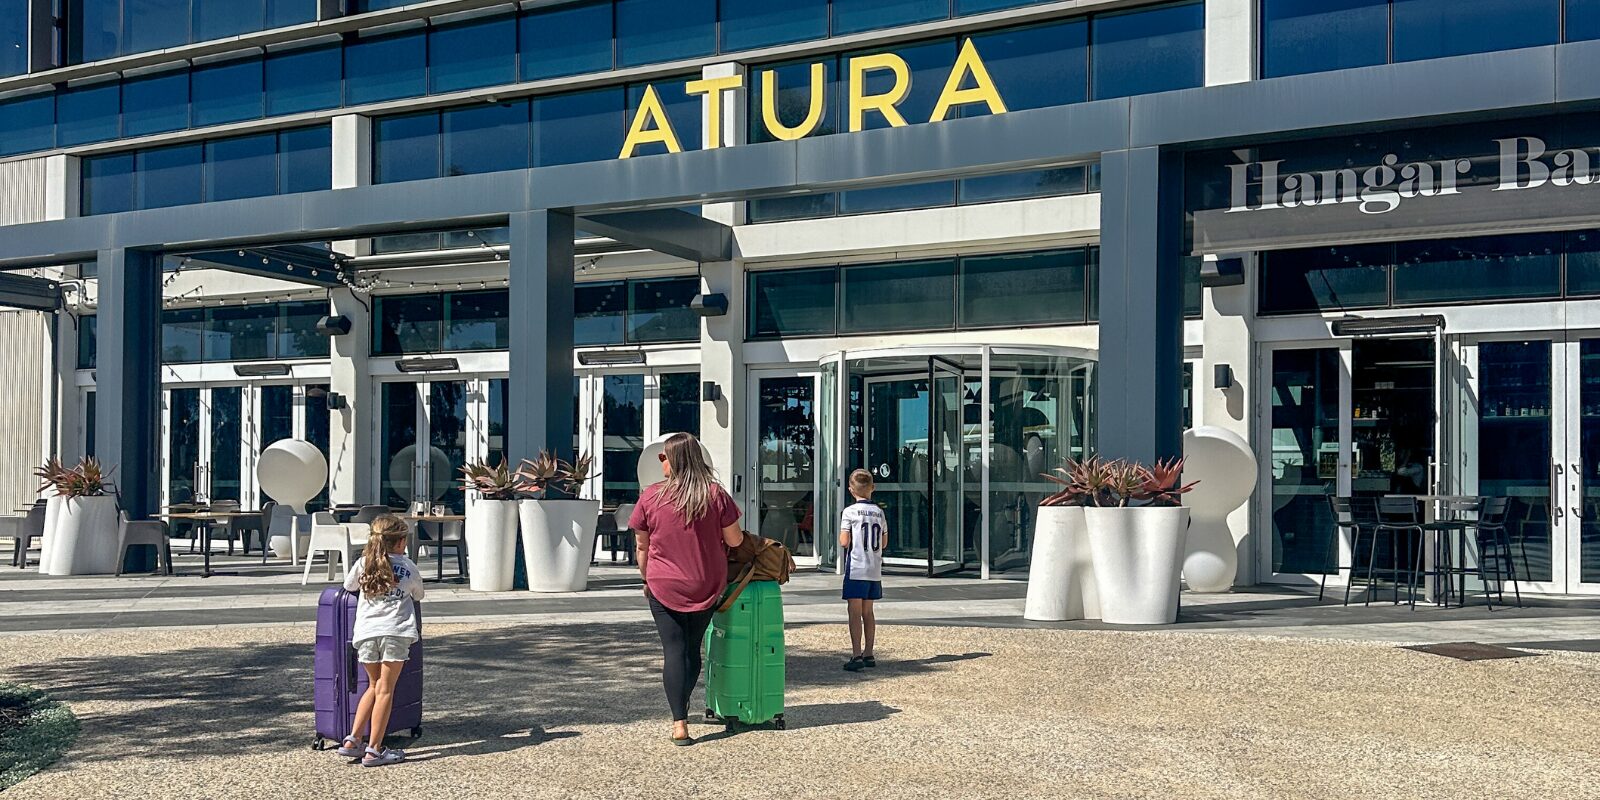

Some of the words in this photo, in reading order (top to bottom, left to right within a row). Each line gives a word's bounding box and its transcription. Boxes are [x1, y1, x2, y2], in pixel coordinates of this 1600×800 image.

[618, 37, 1008, 159] ATURA
[1223, 153, 1472, 214] Hangar
[1491, 136, 1600, 192] Ba
[861, 522, 881, 551] 10
